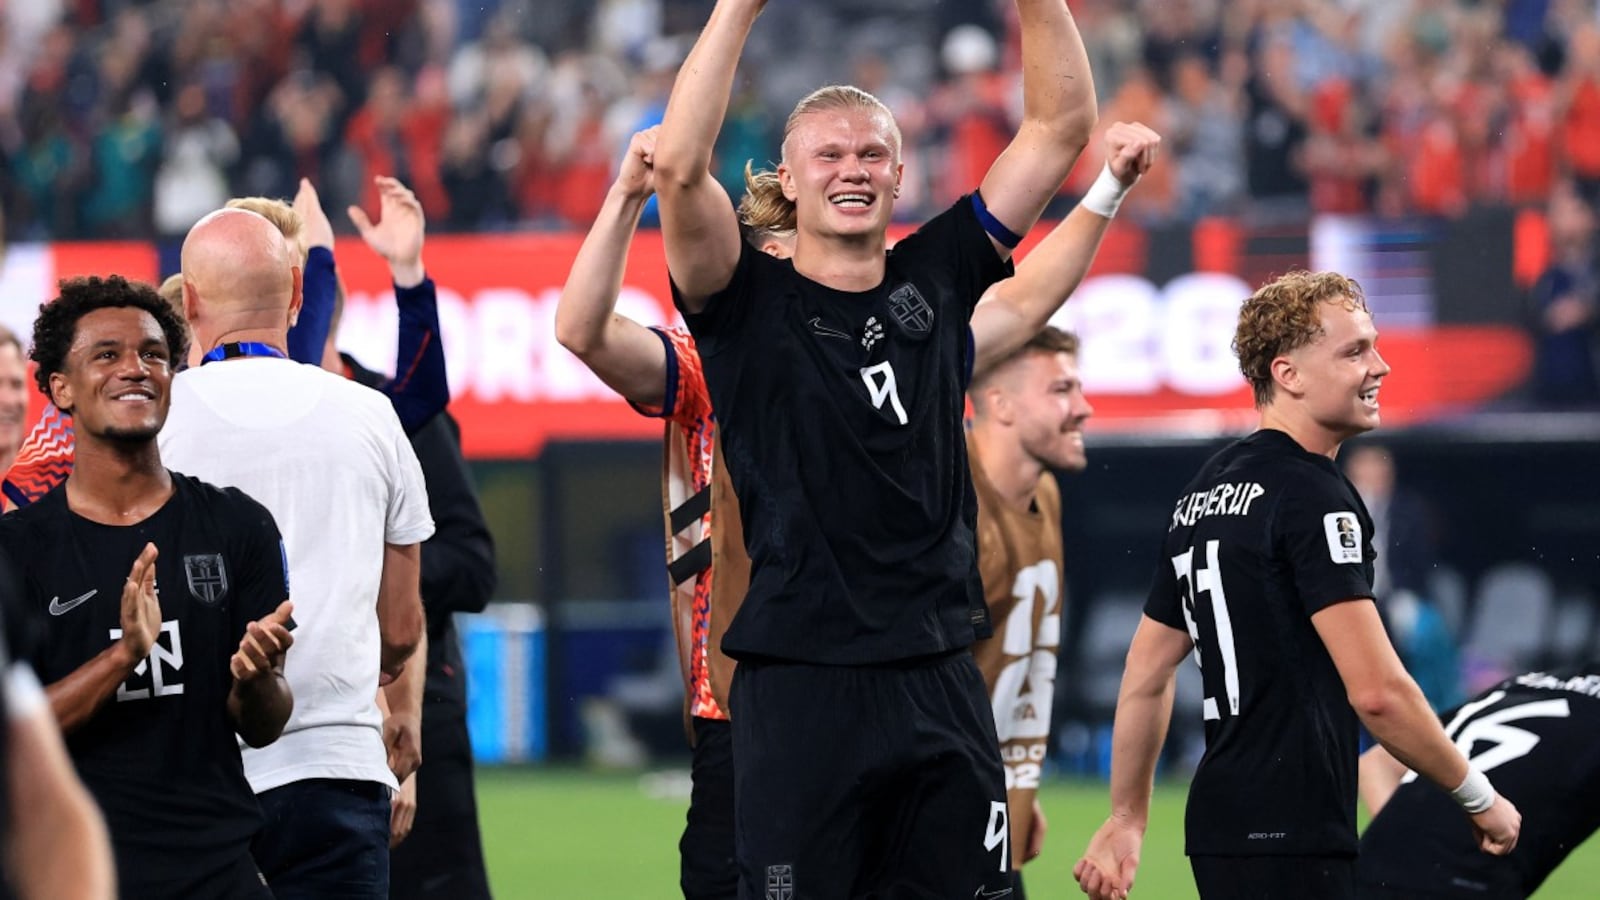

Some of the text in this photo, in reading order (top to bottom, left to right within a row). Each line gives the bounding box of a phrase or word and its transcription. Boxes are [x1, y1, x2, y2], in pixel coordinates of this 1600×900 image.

[1048, 273, 1252, 395] 26
[859, 360, 909, 425] 9
[983, 800, 1008, 873] 9
